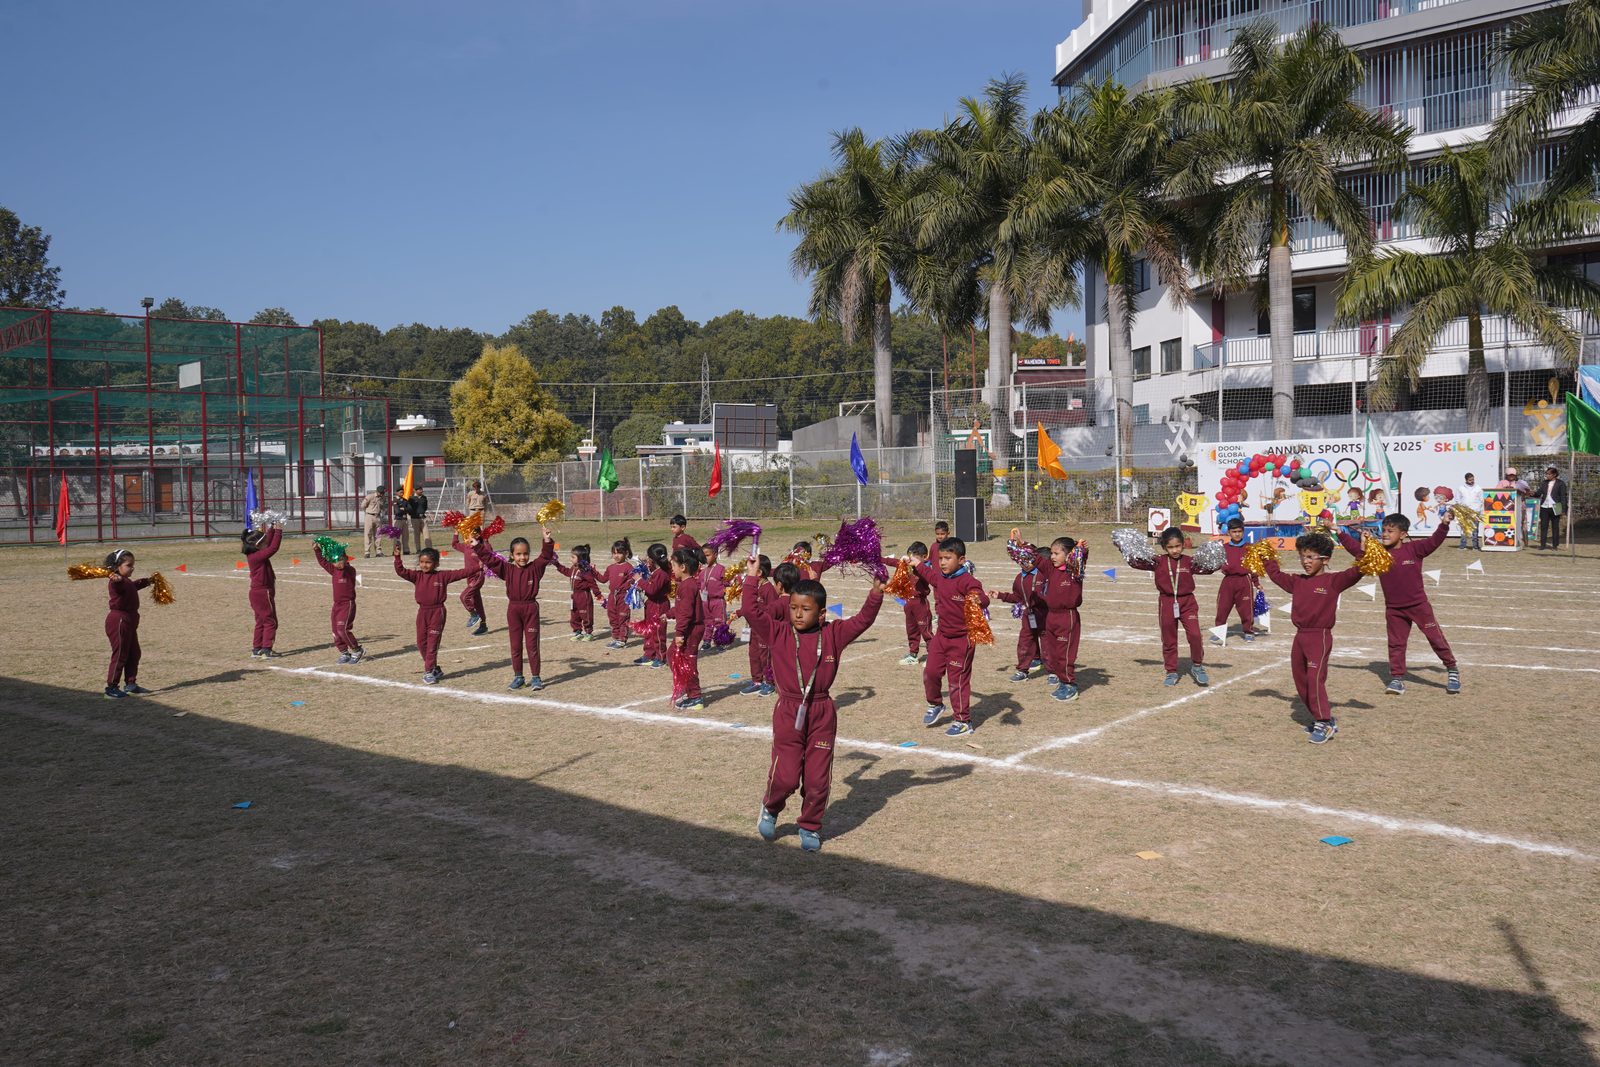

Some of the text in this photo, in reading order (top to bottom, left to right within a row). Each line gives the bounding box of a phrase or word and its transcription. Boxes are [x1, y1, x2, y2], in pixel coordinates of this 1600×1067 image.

[1268, 445, 1315, 455] ANNUAL
[1393, 441, 1422, 452] 2025
[1247, 530, 1254, 544] 1
[1277, 538, 1285, 549] 2
